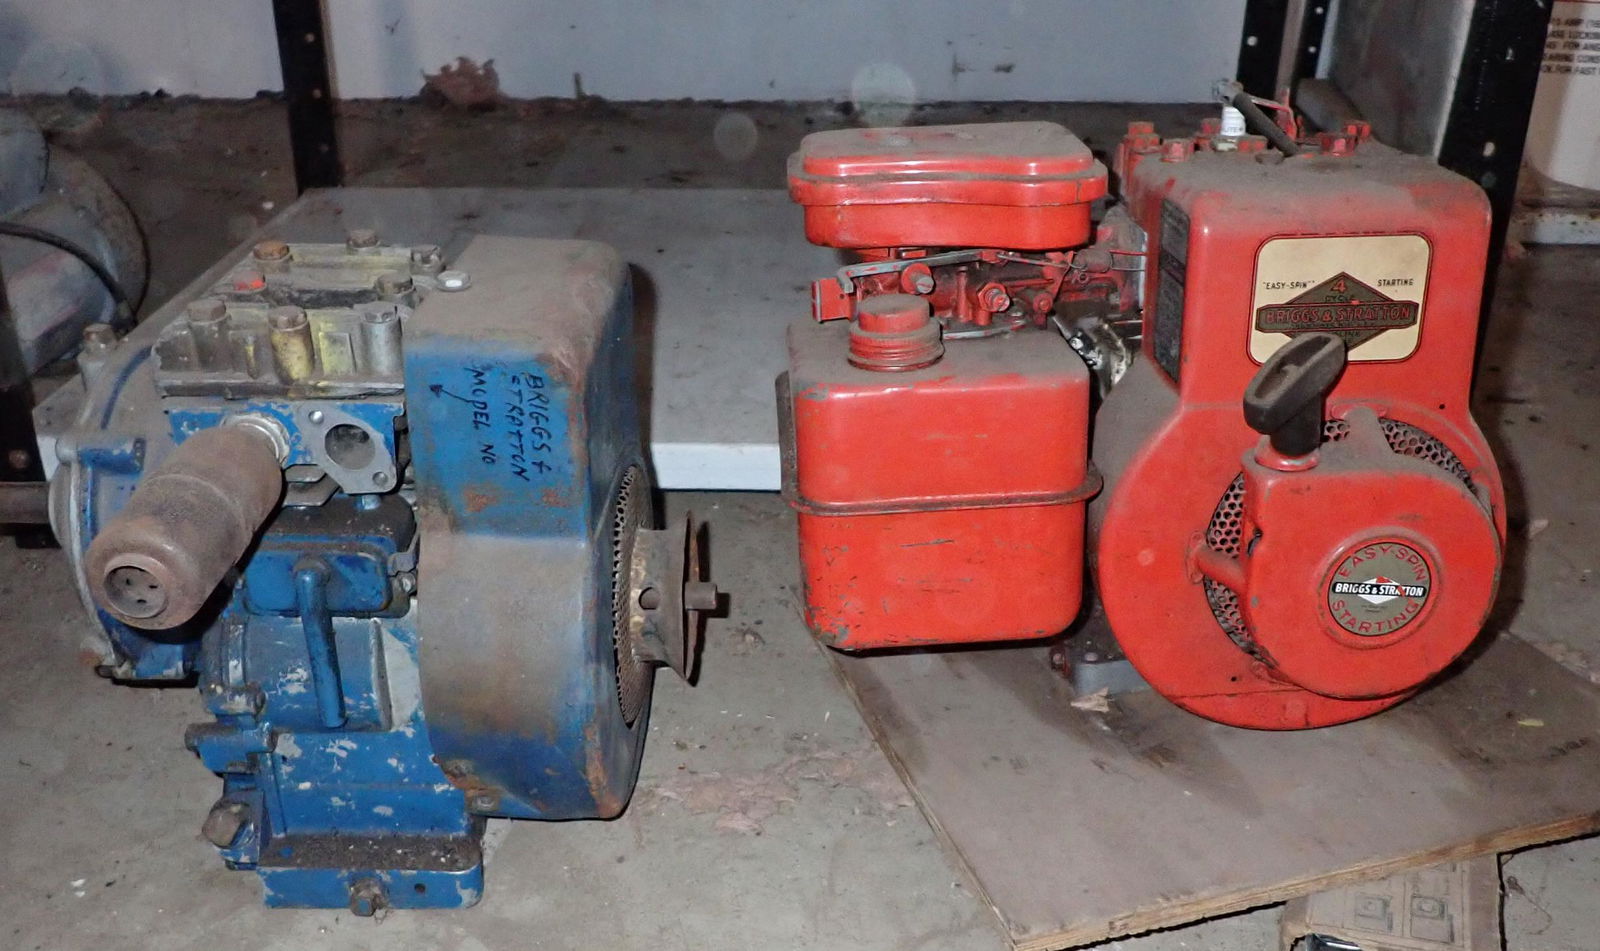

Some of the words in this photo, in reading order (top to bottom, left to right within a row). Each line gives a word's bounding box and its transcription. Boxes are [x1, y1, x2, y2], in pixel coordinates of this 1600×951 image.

[1330, 280, 1347, 293] 4
[1377, 278, 1414, 287] STARTING
[1266, 309, 1319, 324] BRIGGS
[1322, 310, 1333, 322] &
[1336, 304, 1410, 321] STRATTON
[464, 367, 491, 430] MODEL
[480, 443, 497, 465] NO
[522, 372, 552, 452] BRIGGS
[1335, 583, 1371, 594] BRIGGS
[1371, 586, 1378, 594] &
[1332, 600, 1419, 632] STARTING
